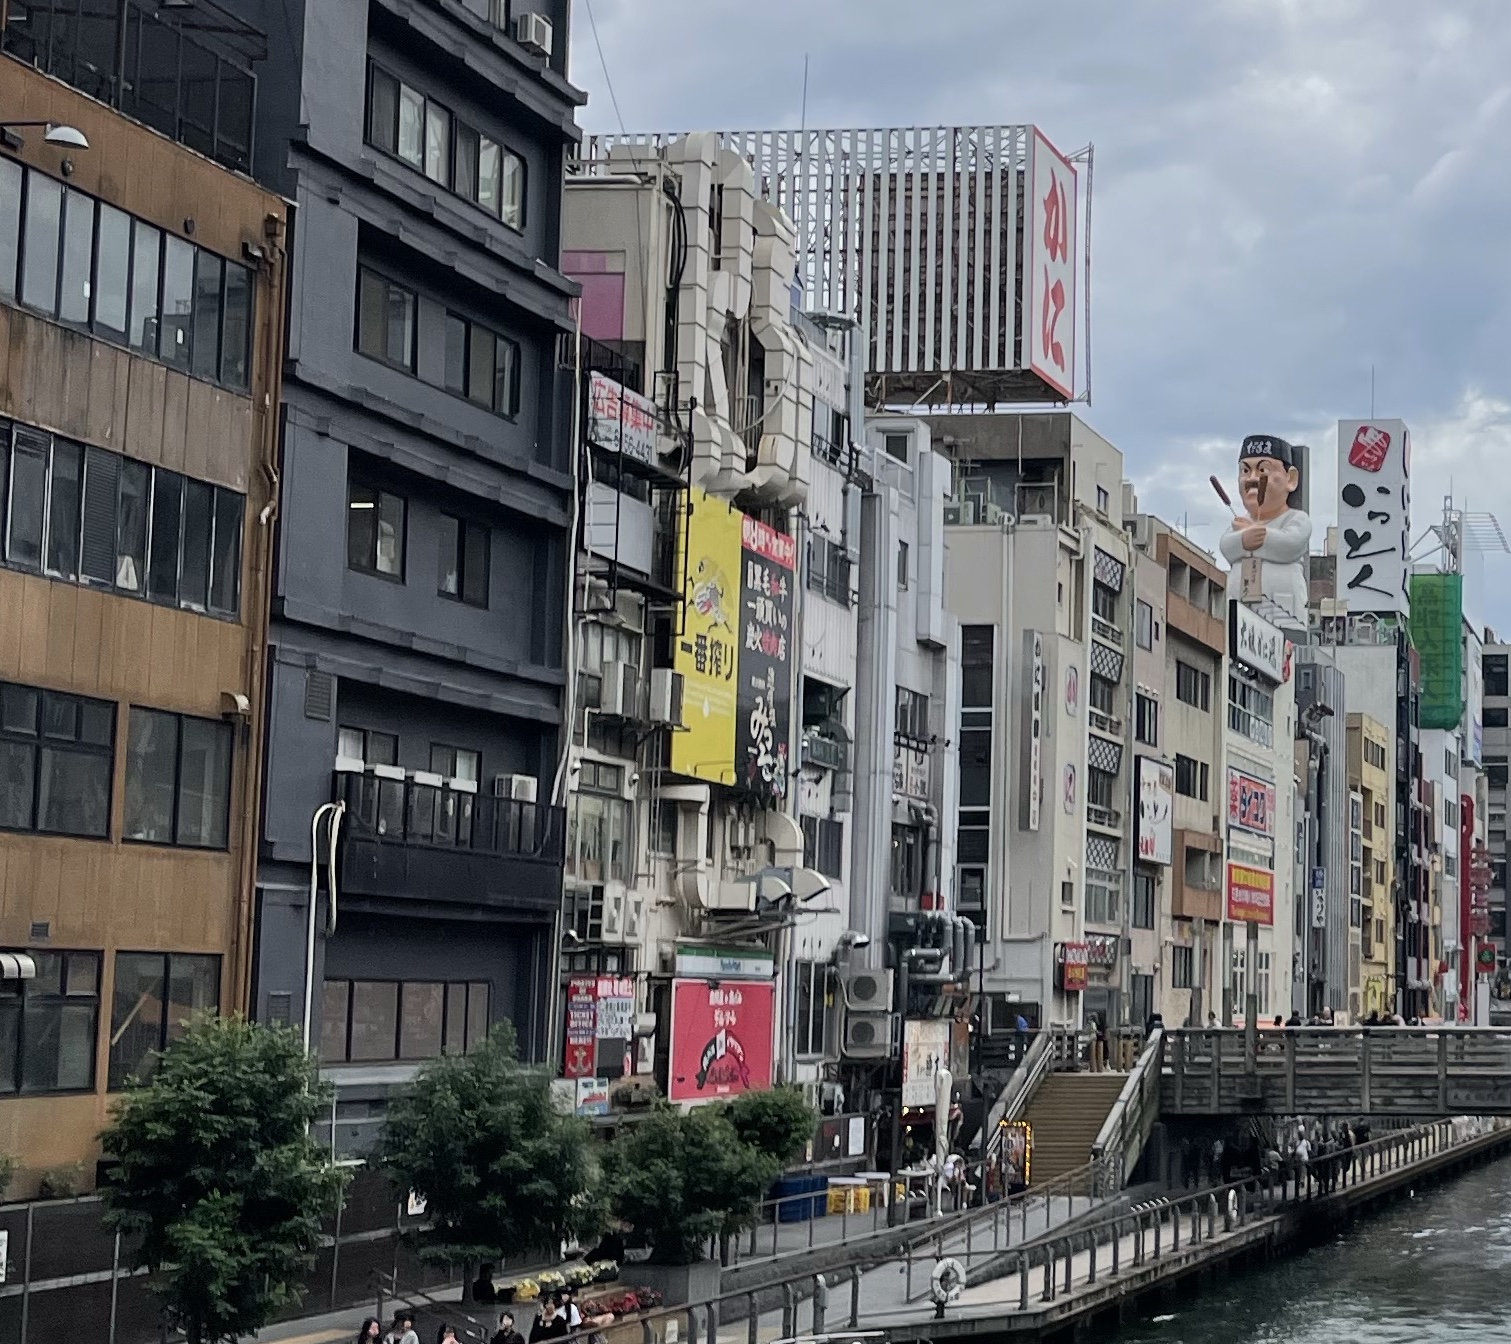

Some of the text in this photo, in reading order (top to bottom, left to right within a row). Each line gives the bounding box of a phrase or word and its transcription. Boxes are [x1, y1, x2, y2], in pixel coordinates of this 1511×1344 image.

[1042, 166, 1068, 374] かに
[1341, 482, 1397, 599] いっとく
[680, 633, 734, 682] 一番搾り
